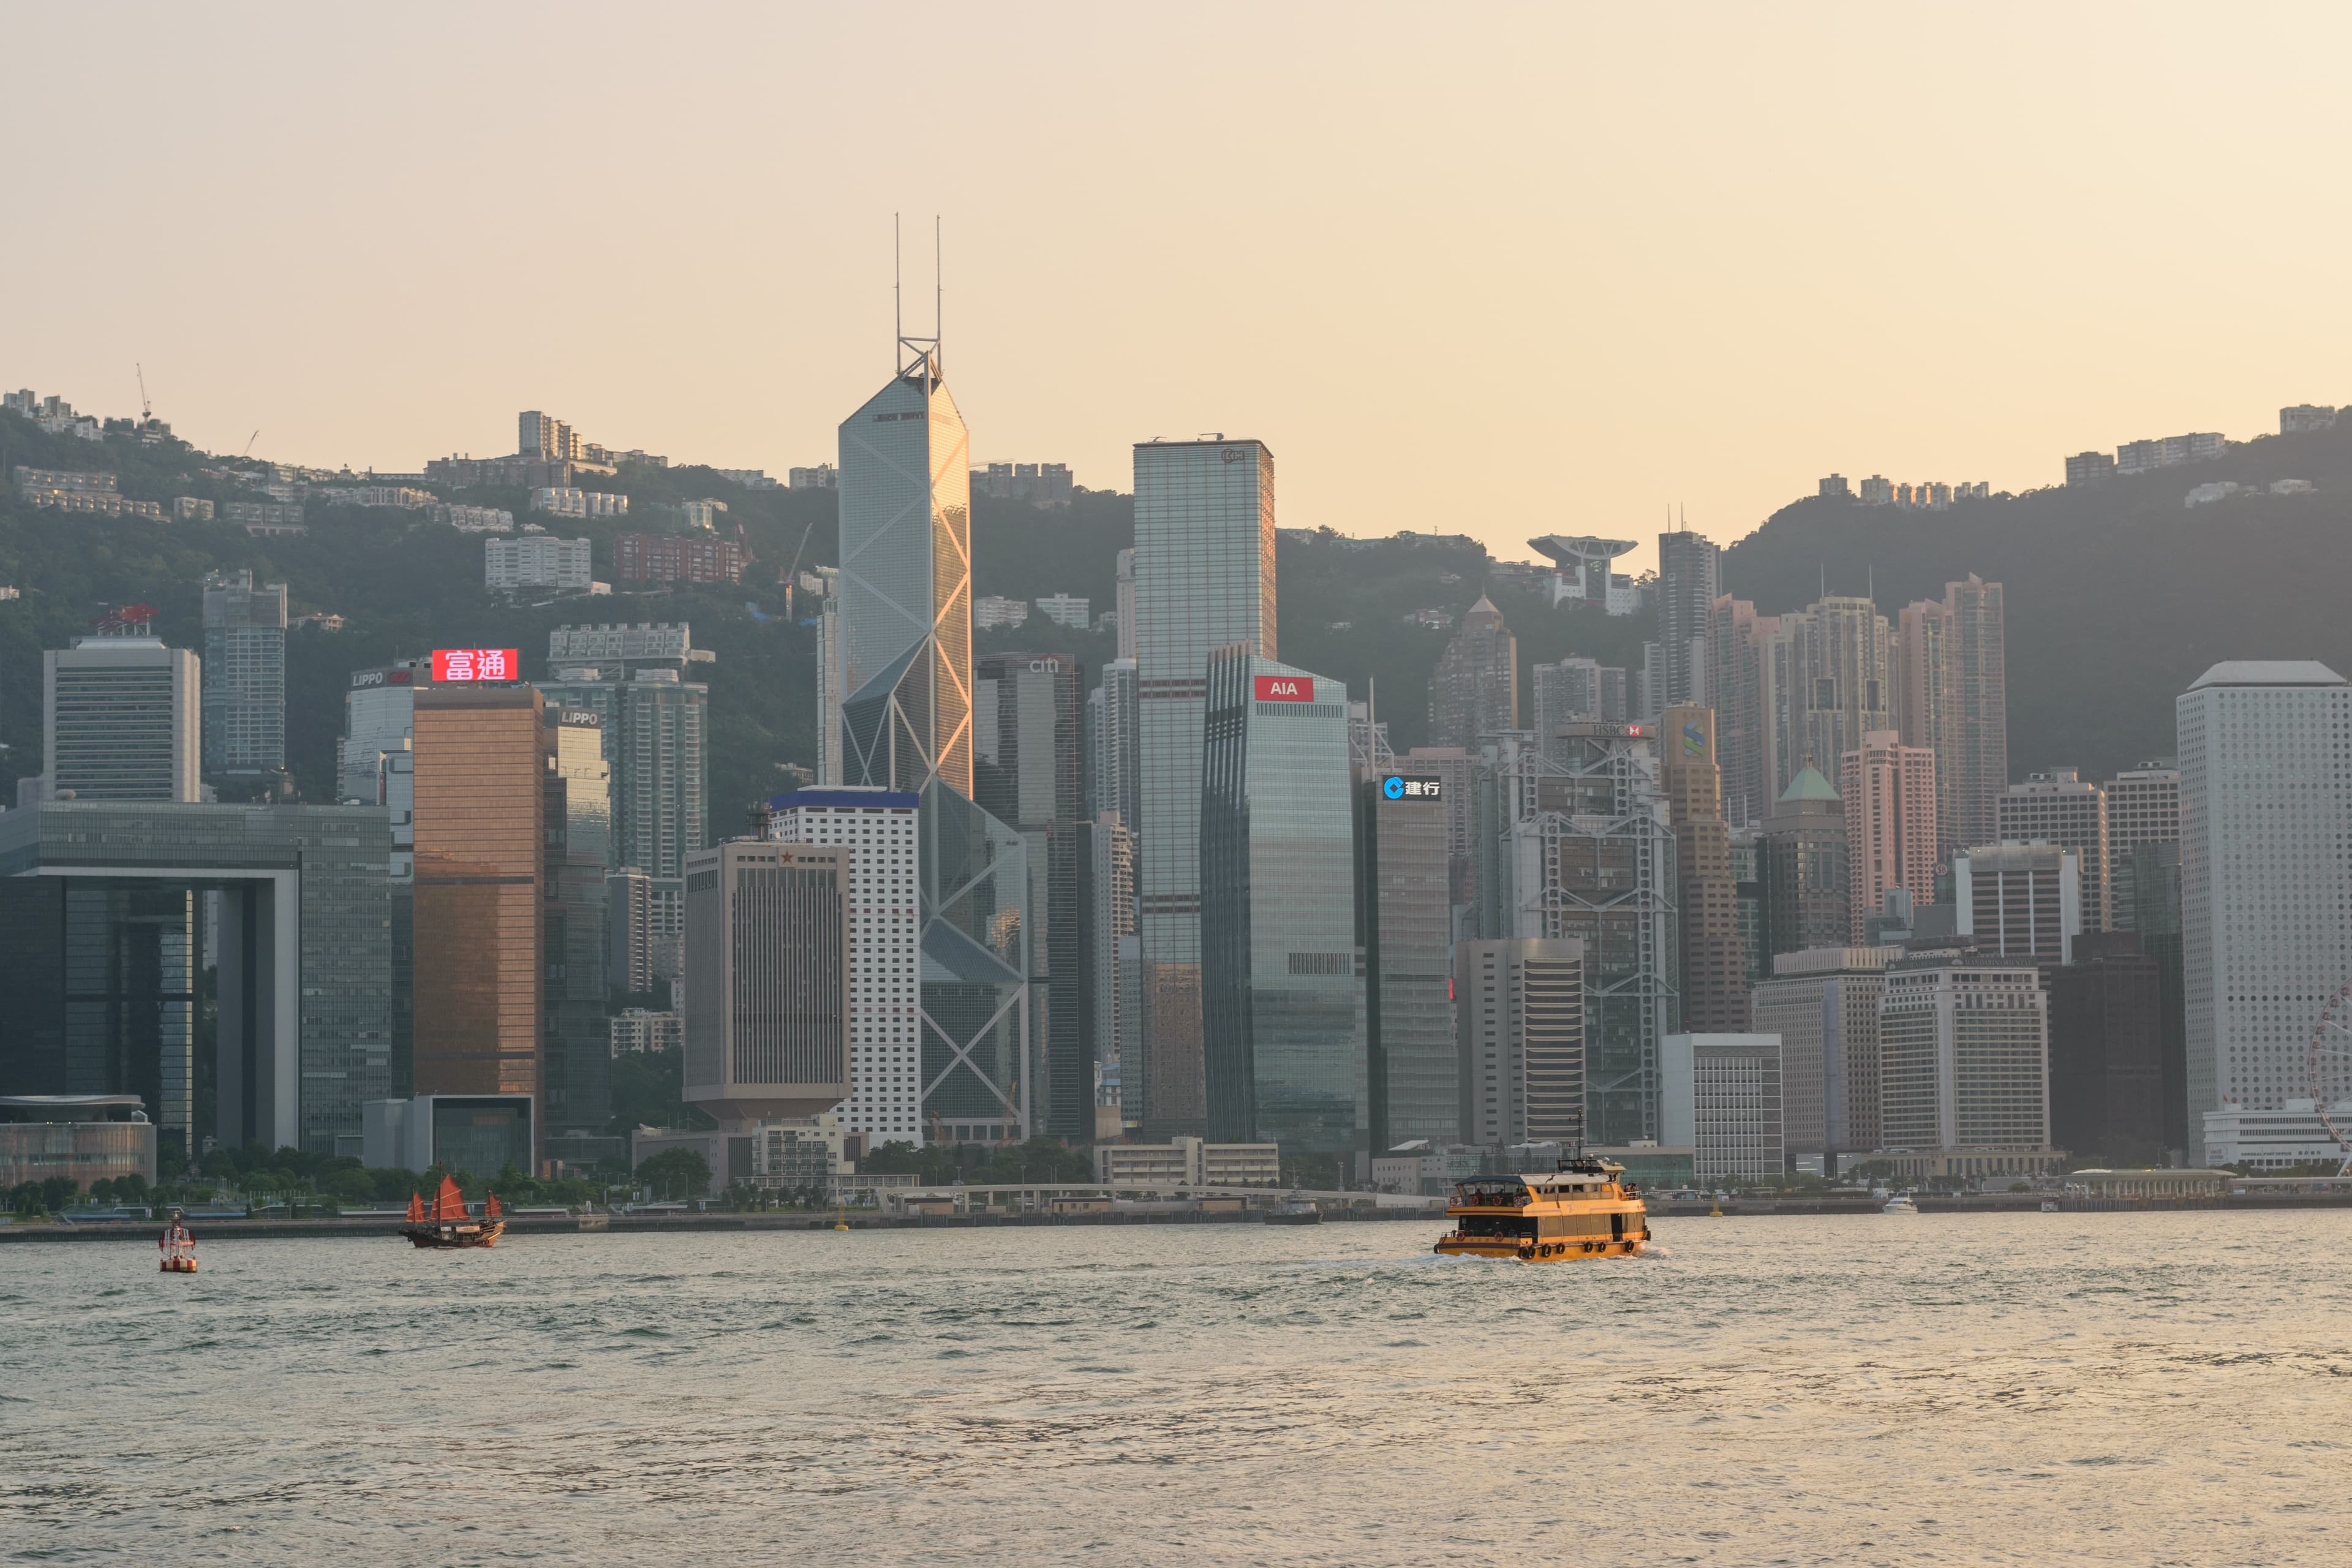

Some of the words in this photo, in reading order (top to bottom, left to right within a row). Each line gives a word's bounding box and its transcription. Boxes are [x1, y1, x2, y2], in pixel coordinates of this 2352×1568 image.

[445, 650, 505, 680] 富通
[1030, 657, 1058, 673] citi
[352, 672, 383, 687] LIPPO
[1270, 682, 1298, 695] AIA
[561, 711, 598, 725] LIPPO
[1593, 725, 1625, 736] HSBC
[1405, 782, 1440, 795] 建行
